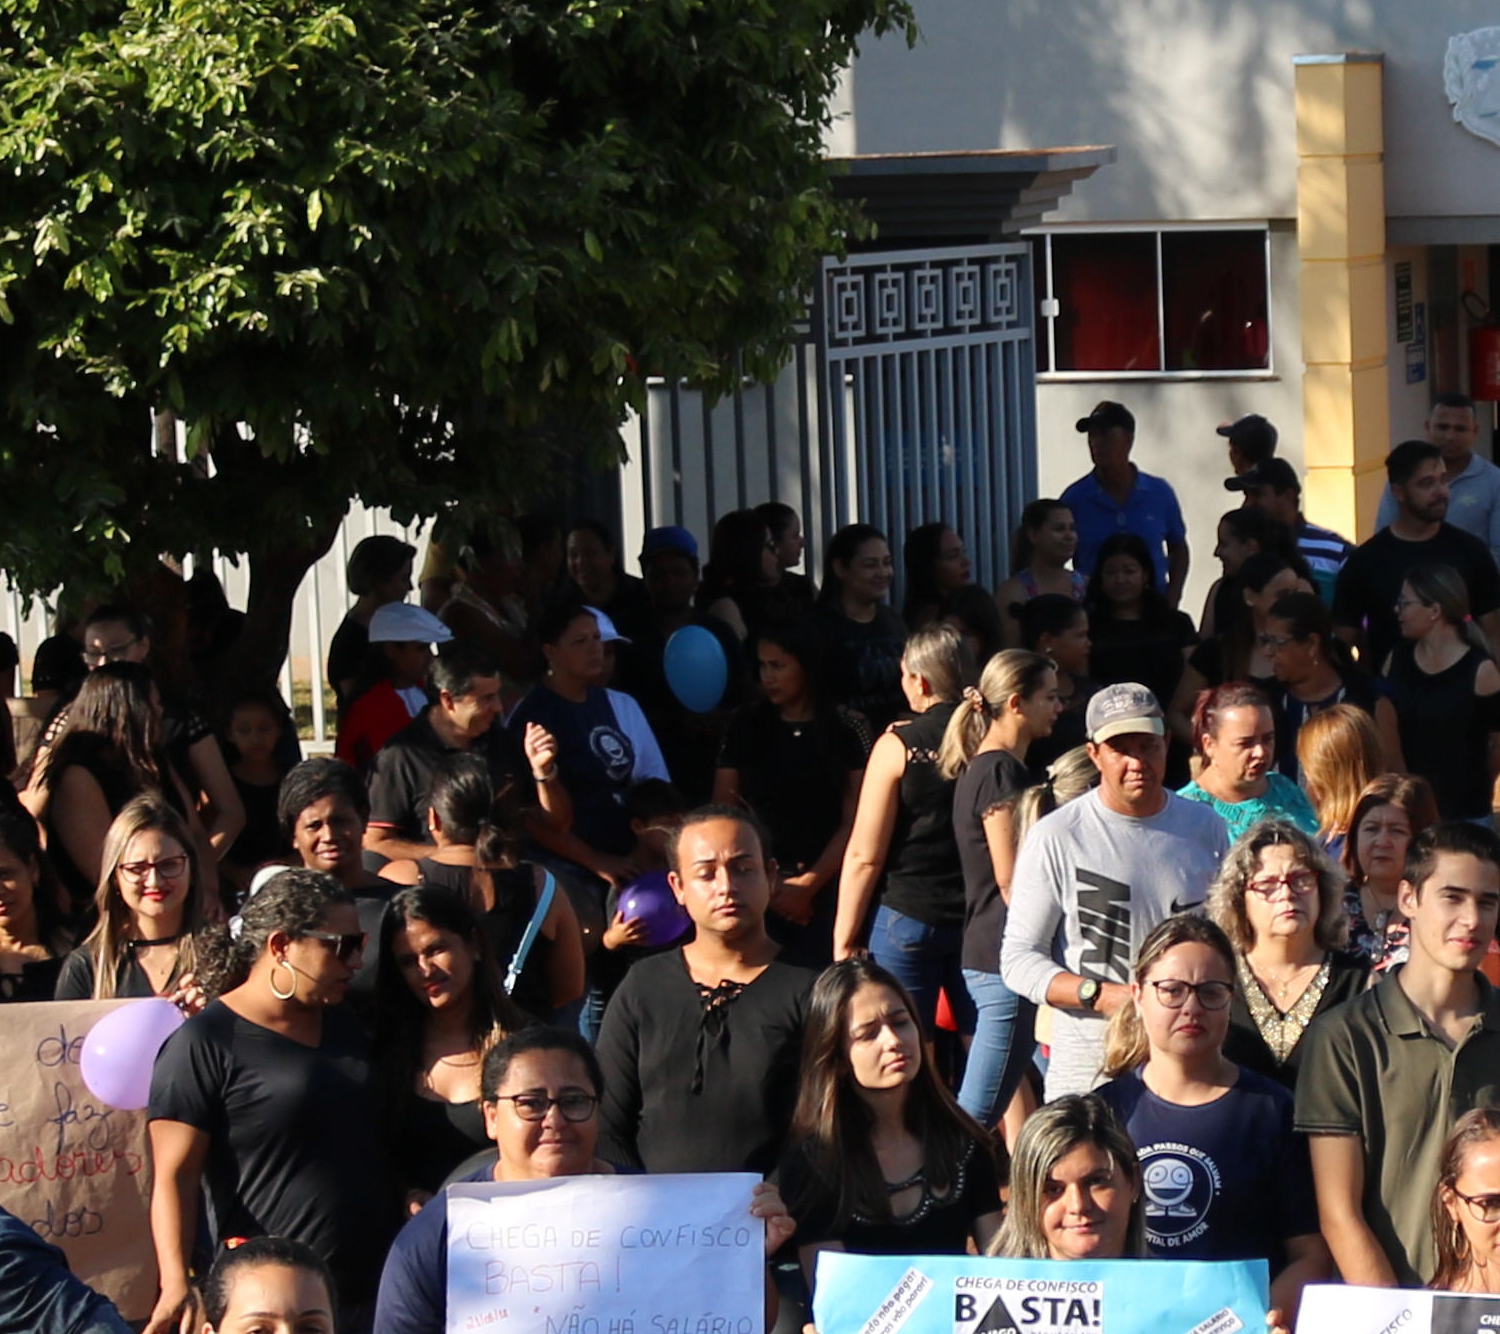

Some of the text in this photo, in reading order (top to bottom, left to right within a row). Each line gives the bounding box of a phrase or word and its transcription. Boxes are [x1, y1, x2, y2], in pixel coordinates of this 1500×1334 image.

[1075, 868, 1131, 984] NIK
[466, 1223, 751, 1250] CHEGA DE CONFISCO
[955, 1276, 1098, 1294] CHEGA DE CONFISCO
